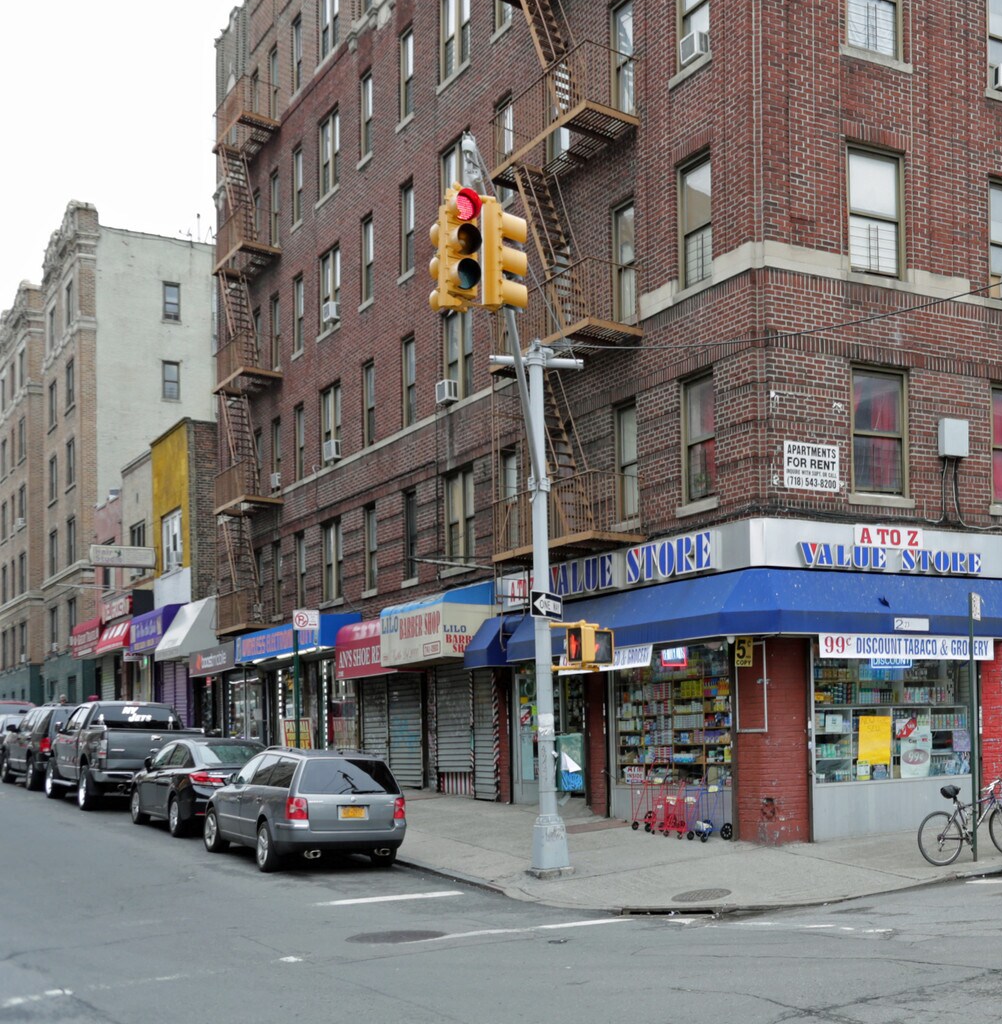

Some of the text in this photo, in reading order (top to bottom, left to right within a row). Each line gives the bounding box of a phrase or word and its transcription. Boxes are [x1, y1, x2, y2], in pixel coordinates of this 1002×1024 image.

[787, 444, 836, 459] APARTMENTS
[787, 456, 836, 471] FOR RENT
[787, 476, 837, 489] (718) 543-8200
[860, 527, 919, 547] A TO Z
[549, 531, 711, 596] VALUE STORE
[799, 542, 982, 574] VALUE STORE
[540, 599, 561, 612] ONE WAY
[381, 616, 399, 634] LILO
[399, 614, 423, 640] BARBER
[424, 610, 441, 635] SHOP
[443, 625, 467, 633] LILO
[446, 634, 473, 644] BARB
[452, 644, 465, 653] SH
[856, 637, 902, 655] DISCOUNT
[904, 638, 938, 655] TABACO
[940, 640, 949, 656] &
[950, 639, 989, 657] GROERY
[352, 645, 371, 667] SHOE
[371, 644, 381, 664] RE
